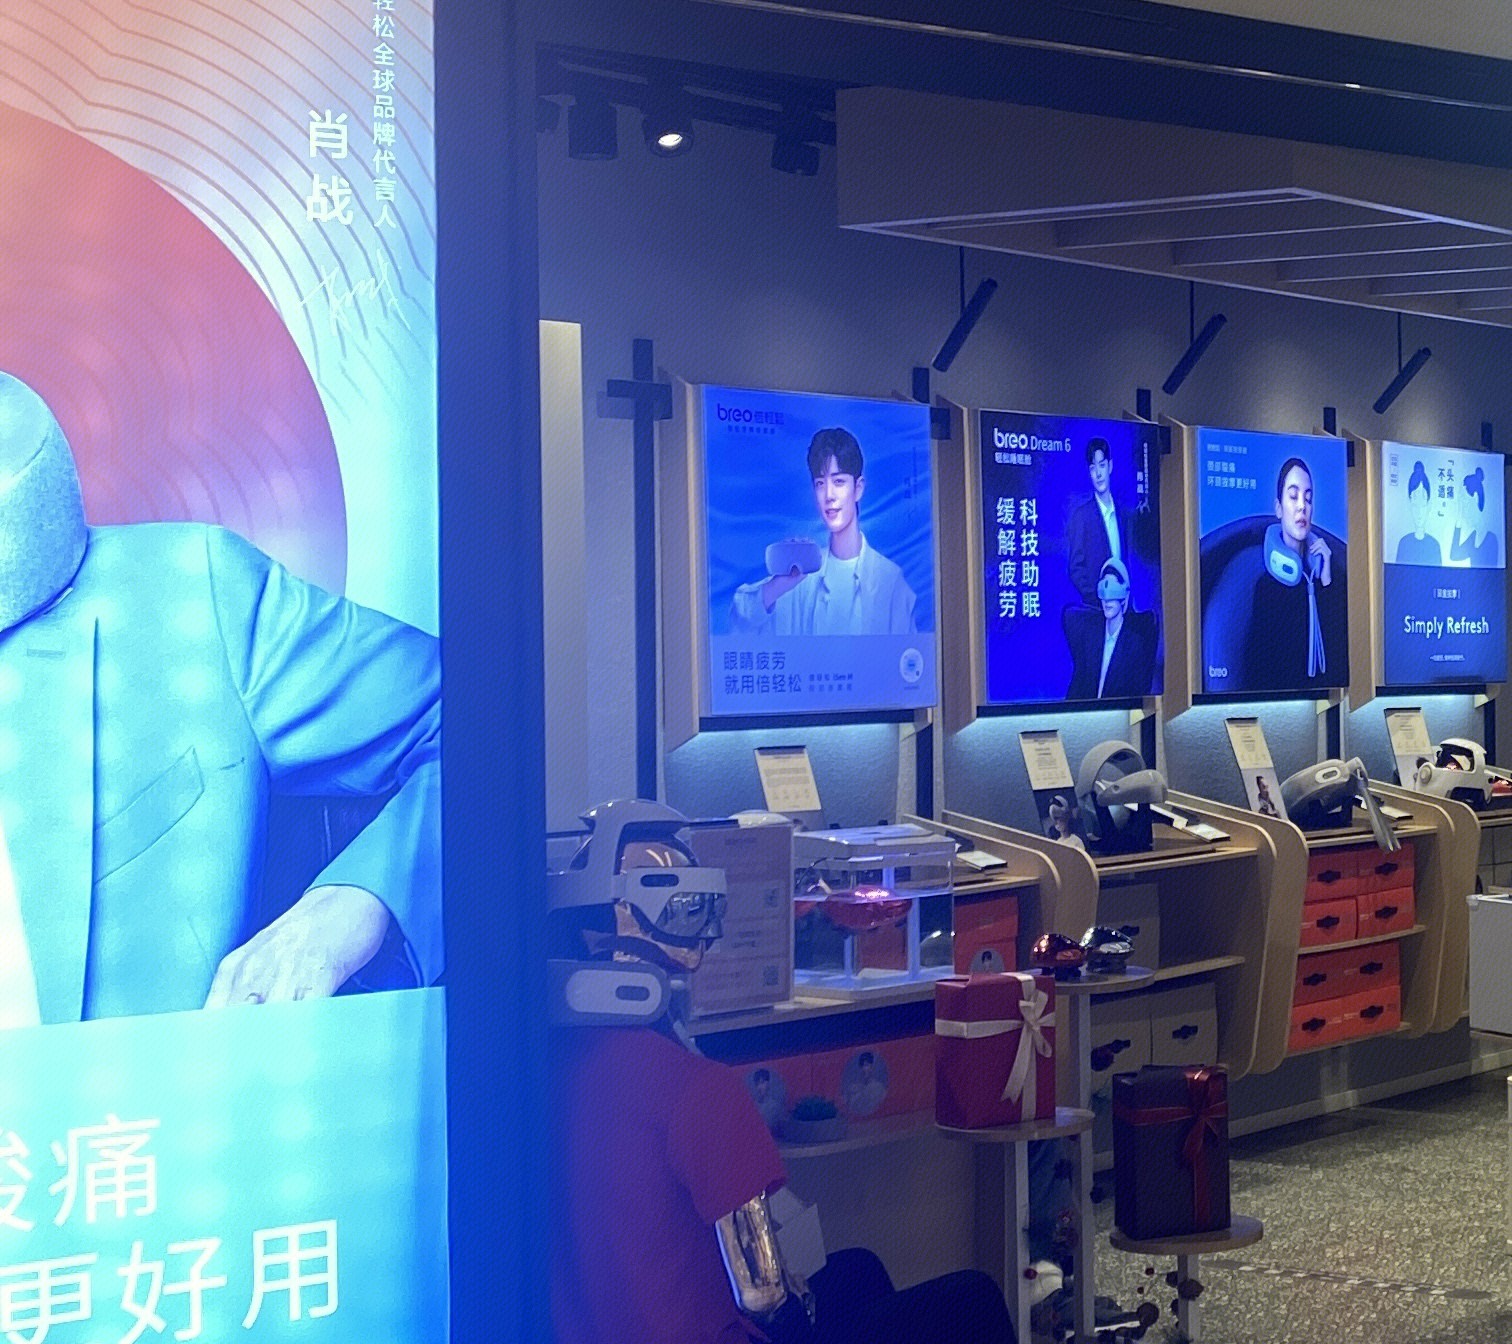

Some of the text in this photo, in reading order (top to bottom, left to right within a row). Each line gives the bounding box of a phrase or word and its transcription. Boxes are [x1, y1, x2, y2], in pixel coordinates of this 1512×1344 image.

[305, 108, 354, 226] 肖战
[717, 403, 753, 423] breo
[993, 427, 1072, 453] breo Dream 6
[996, 497, 1017, 618] 缓解疲劳
[1019, 498, 1041, 618] 科技助眠
[1404, 615, 1490, 640] Simply Refresh
[723, 651, 786, 671] 眼睛疲劳
[724, 673, 802, 695] 就用倍轻松
